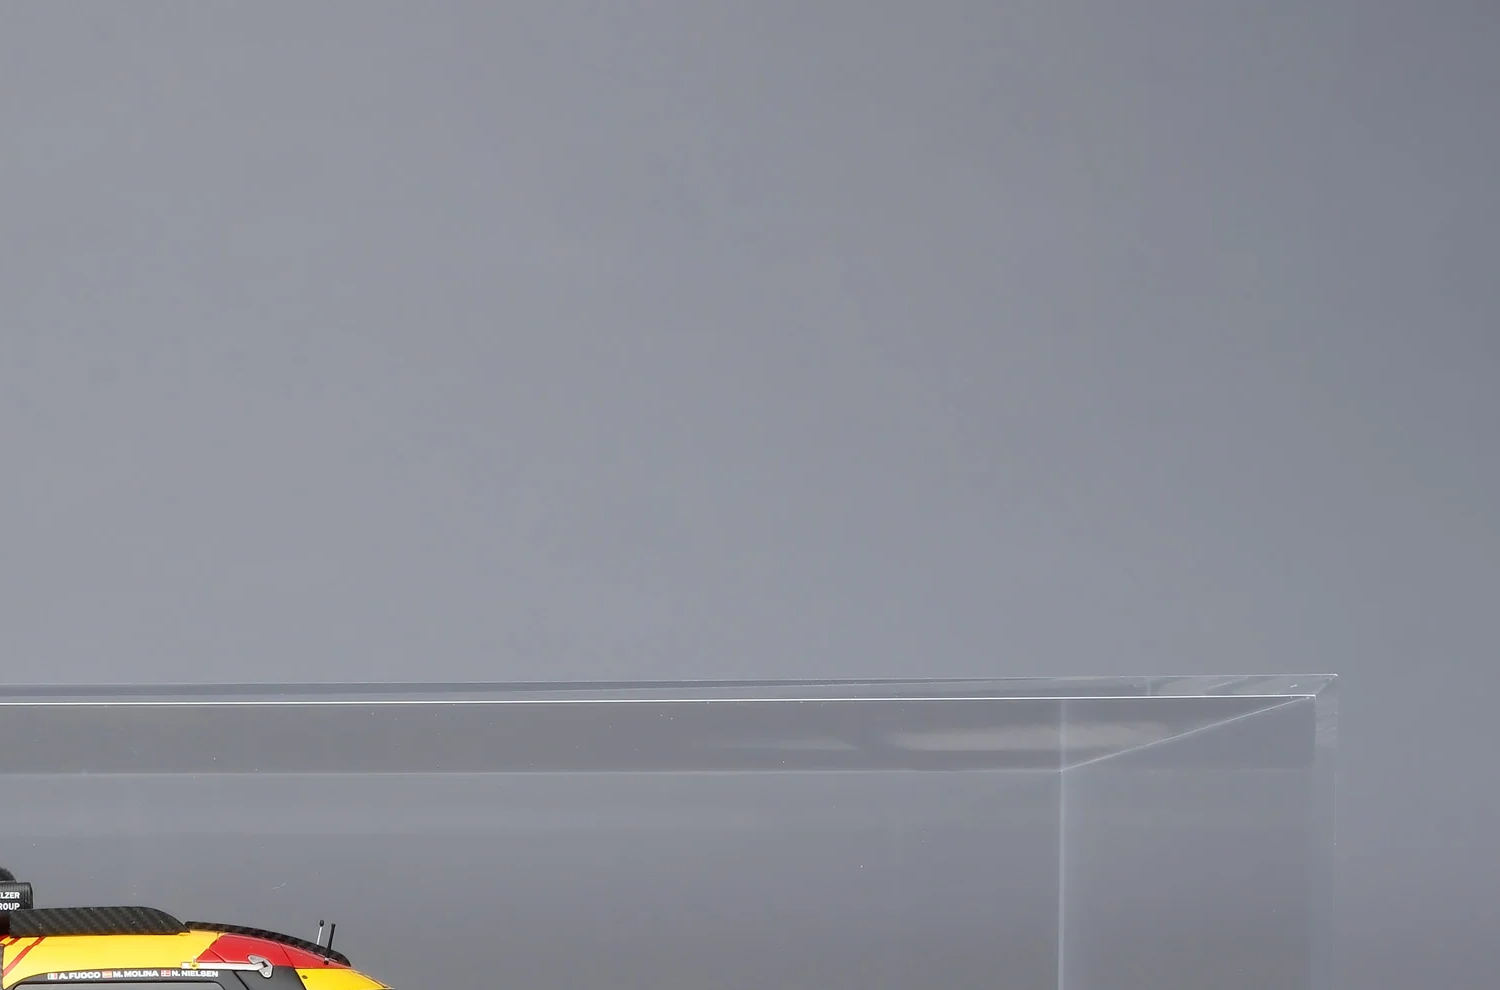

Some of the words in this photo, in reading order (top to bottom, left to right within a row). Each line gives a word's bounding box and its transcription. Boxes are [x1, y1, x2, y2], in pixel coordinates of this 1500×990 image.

[69, 971, 100, 979] FUOCO
[113, 970, 123, 978] M.
[182, 970, 218, 978] NIELSEN
